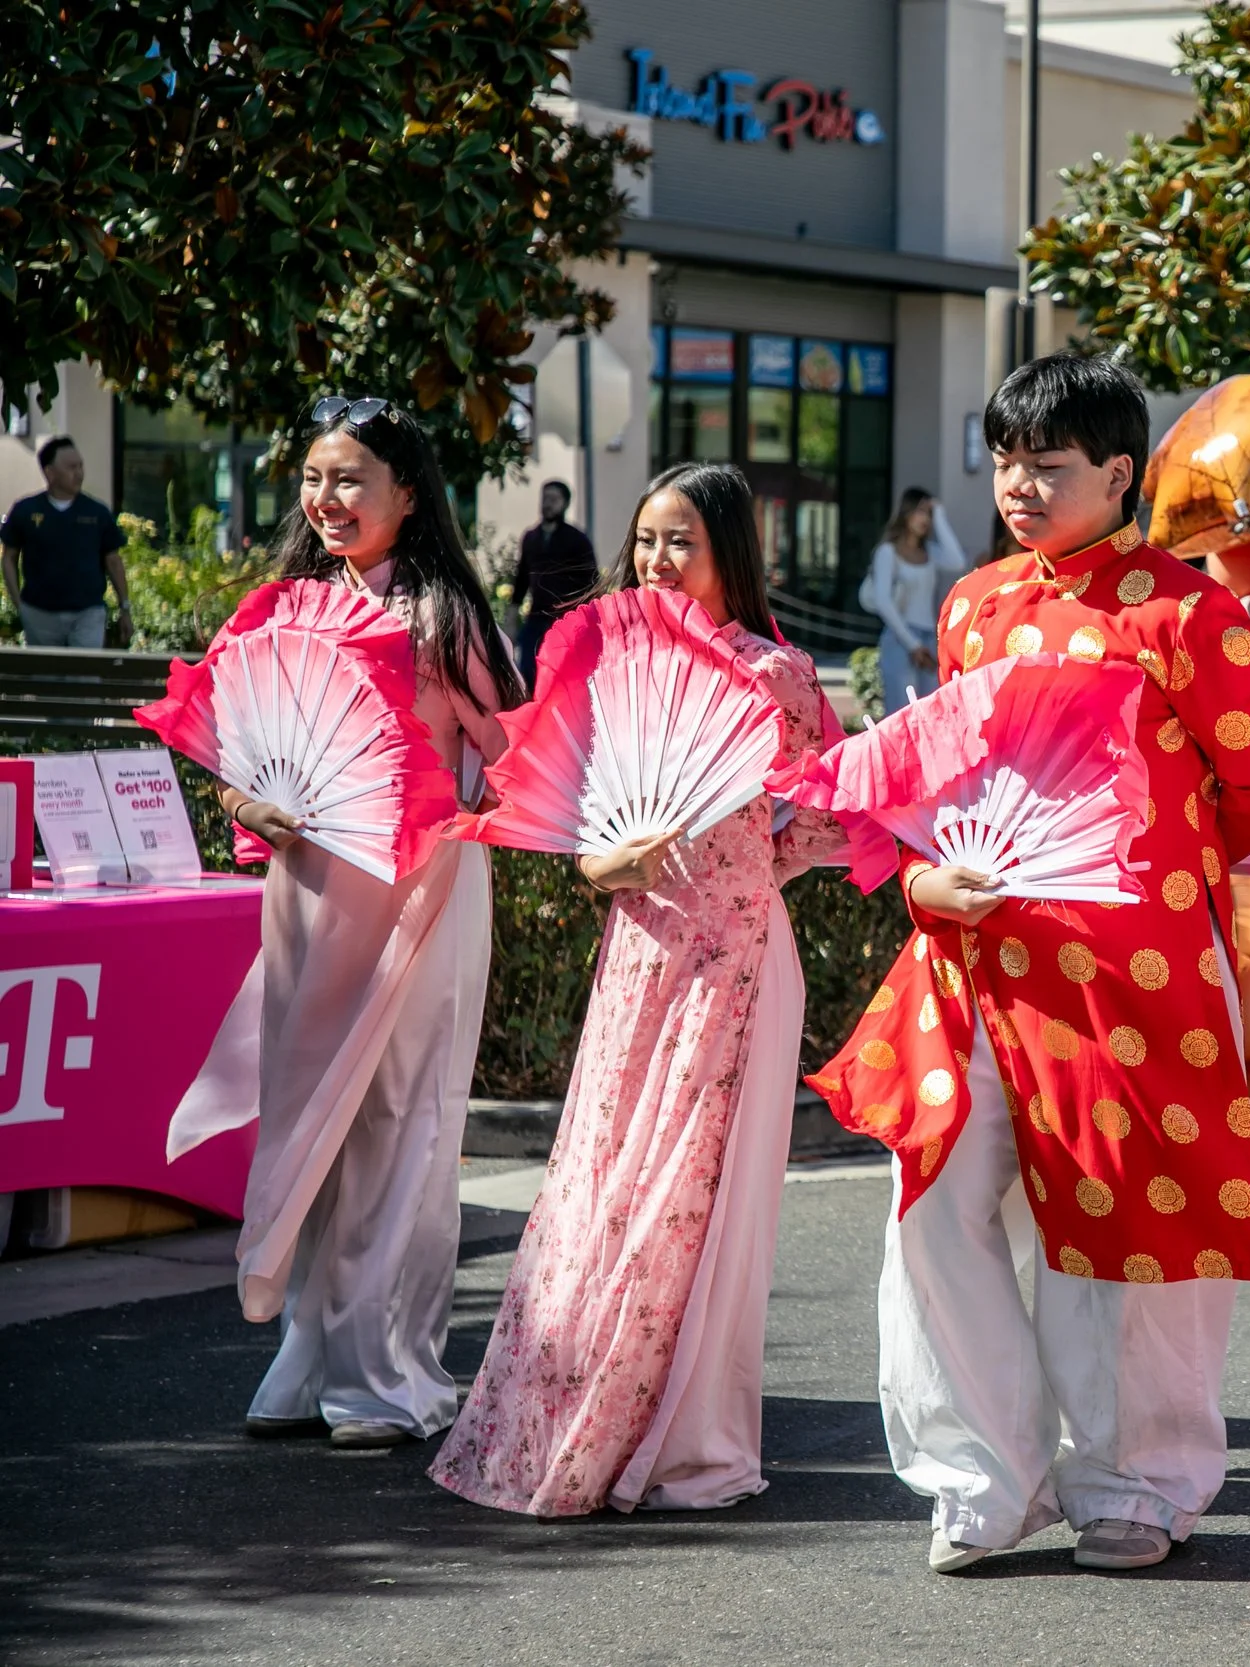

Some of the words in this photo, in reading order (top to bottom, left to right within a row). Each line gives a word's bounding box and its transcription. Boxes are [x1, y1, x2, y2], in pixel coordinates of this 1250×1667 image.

[115, 781, 141, 795] Get
[141, 779, 172, 793] $100
[54, 790, 64, 800] up
[41, 801, 60, 810] every
[61, 799, 83, 808] month
[131, 795, 165, 810] each
